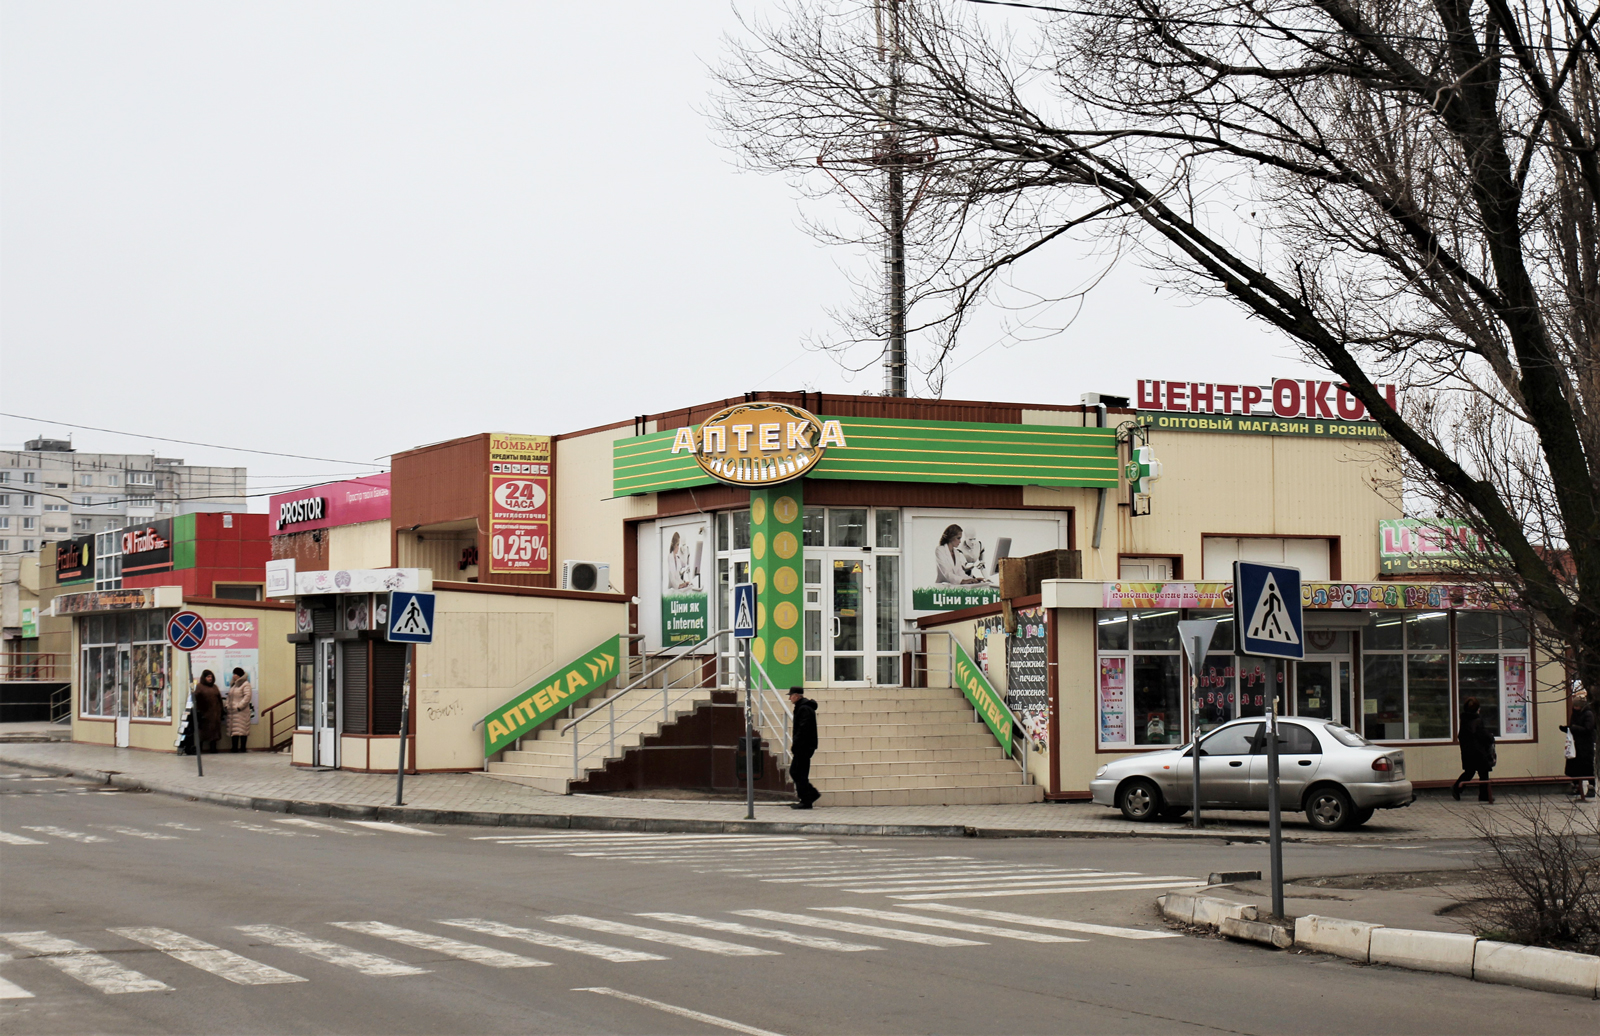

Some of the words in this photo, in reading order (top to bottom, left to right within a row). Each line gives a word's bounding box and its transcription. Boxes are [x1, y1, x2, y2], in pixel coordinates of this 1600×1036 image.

[1137, 379, 1262, 415] ЦЕНТР
[1159, 416, 1233, 430] ОПТОВЫЙ
[1239, 420, 1309, 434] МАГАЗИН
[1315, 424, 1324, 434] В
[1329, 426, 1391, 439] РОЗНИЦ
[671, 420, 847, 454] АПТЕКА
[491, 439, 549, 453] ЛОМБАРД
[491, 453, 519, 461] КРЕДИТЫ
[505, 483, 534, 500] 24
[280, 496, 324, 525] PROSTOR
[505, 500, 535, 508] ЧАСА
[492, 534, 548, 562] 0,25%
[933, 593, 962, 607] Ціни
[965, 596, 979, 606] як
[983, 596, 990, 606] в
[1302, 584, 1398, 608] Сладкий
[1405, 586, 1441, 608] рай
[670, 601, 688, 616] Ціни
[690, 602, 700, 613] як
[667, 620, 672, 630] в
[673, 616, 704, 630] Internet
[1026, 624, 1045, 638] рай
[1012, 644, 1045, 657] конфеты
[1010, 660, 1045, 672] пирожные
[487, 669, 588, 745] АПТЕКА
[967, 677, 1011, 741] АПТЕКА
[1028, 701, 1046, 714] кофе
